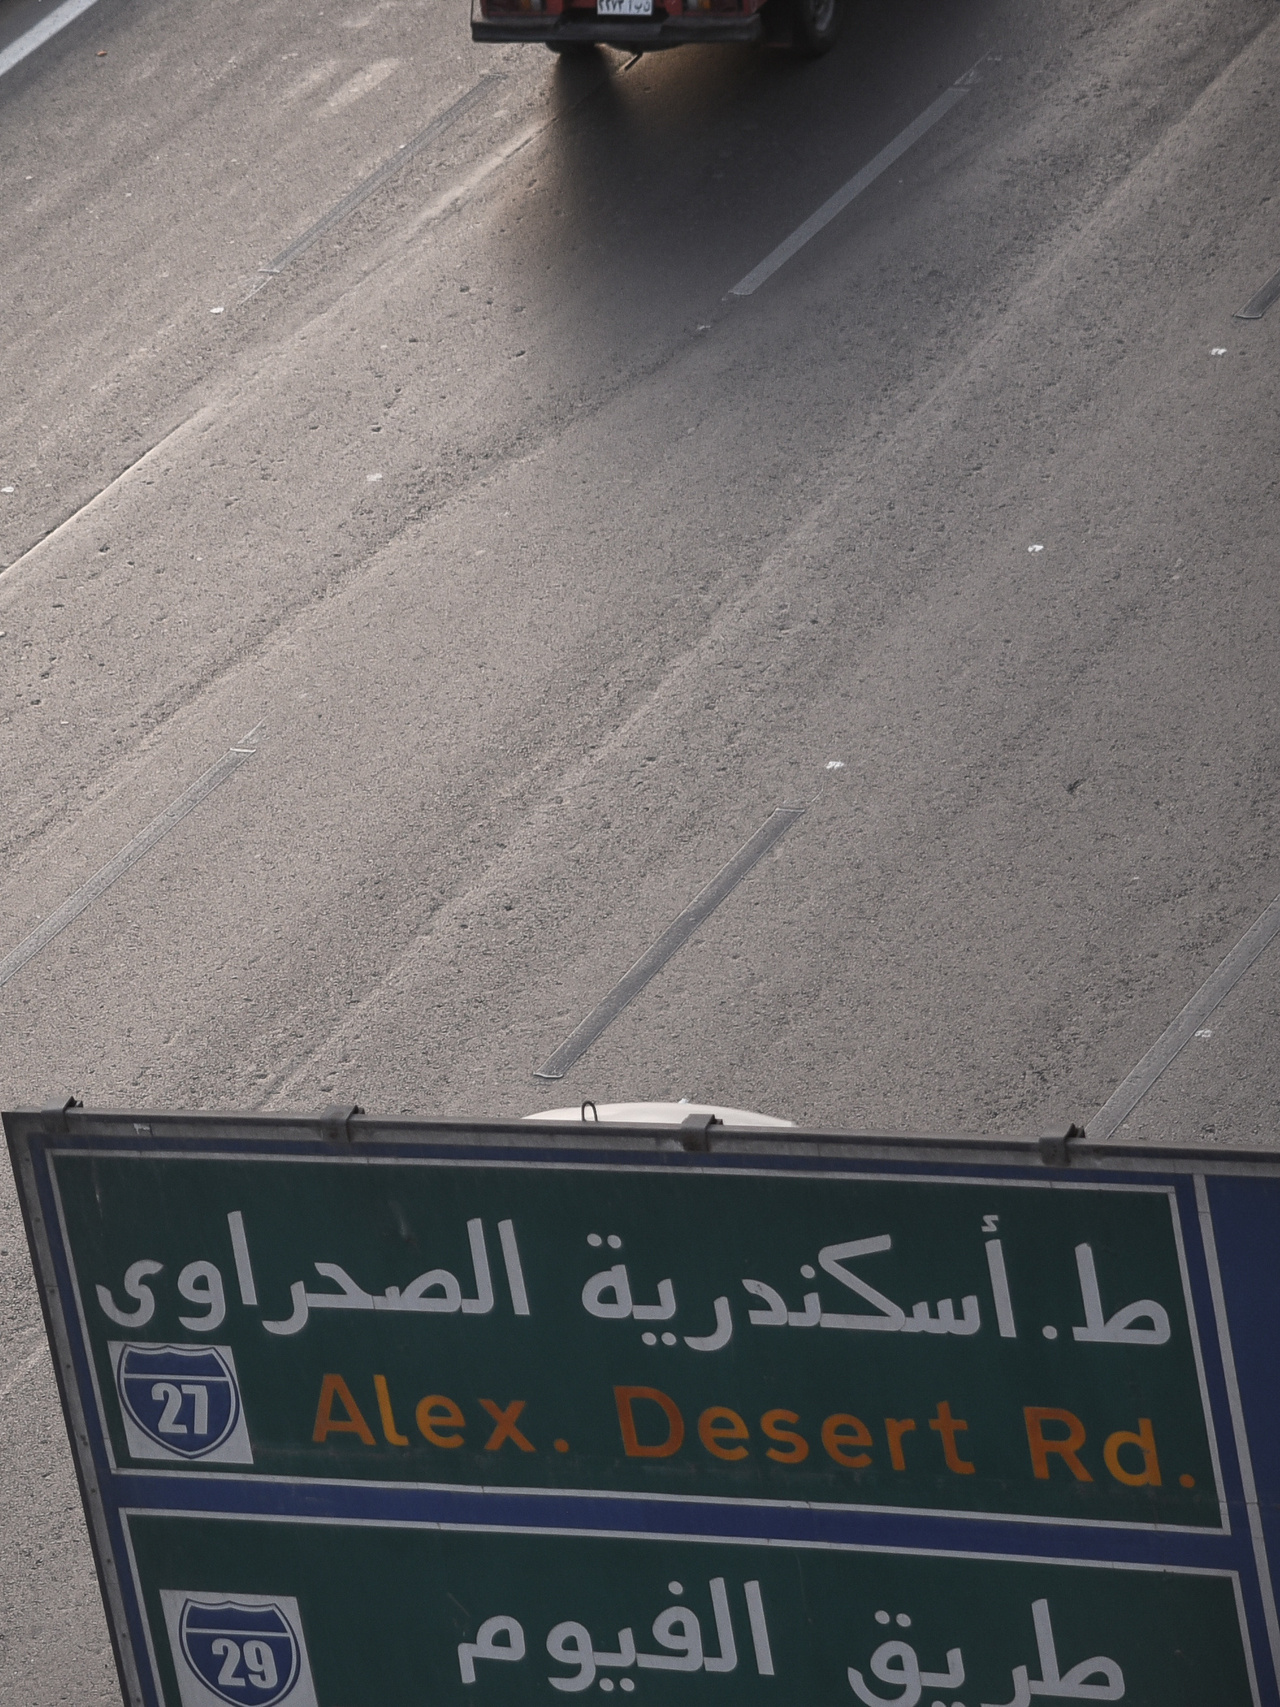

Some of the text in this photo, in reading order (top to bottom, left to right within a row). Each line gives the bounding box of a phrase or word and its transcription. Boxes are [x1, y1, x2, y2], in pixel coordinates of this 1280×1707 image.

[150, 1382, 210, 1436] 27
[312, 1373, 1196, 1488] Alex. Desert Rd.
[210, 1637, 279, 1691] 29
[457, 1576, 1126, 1707] طريق الفيوم
